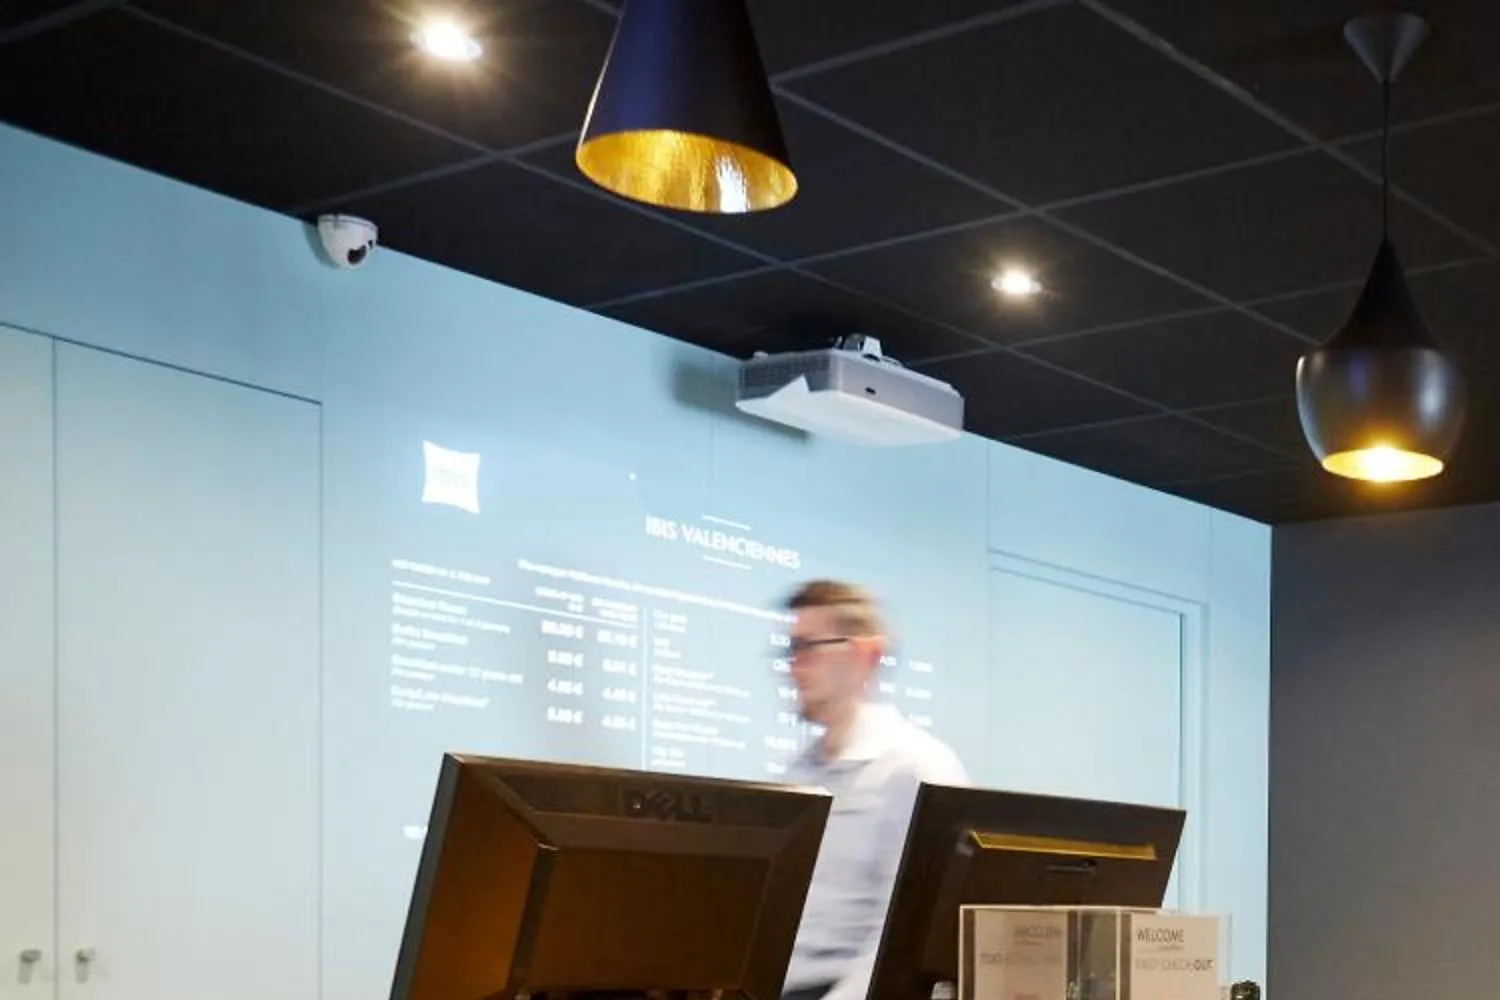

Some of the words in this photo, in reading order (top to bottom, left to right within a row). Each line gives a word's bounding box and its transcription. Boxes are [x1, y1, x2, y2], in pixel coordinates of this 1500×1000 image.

[644, 515, 678, 540] IBIS
[681, 523, 801, 569] VALENCIENNES
[622, 788, 713, 821] DELL
[1136, 928, 1184, 943] WELCOME
